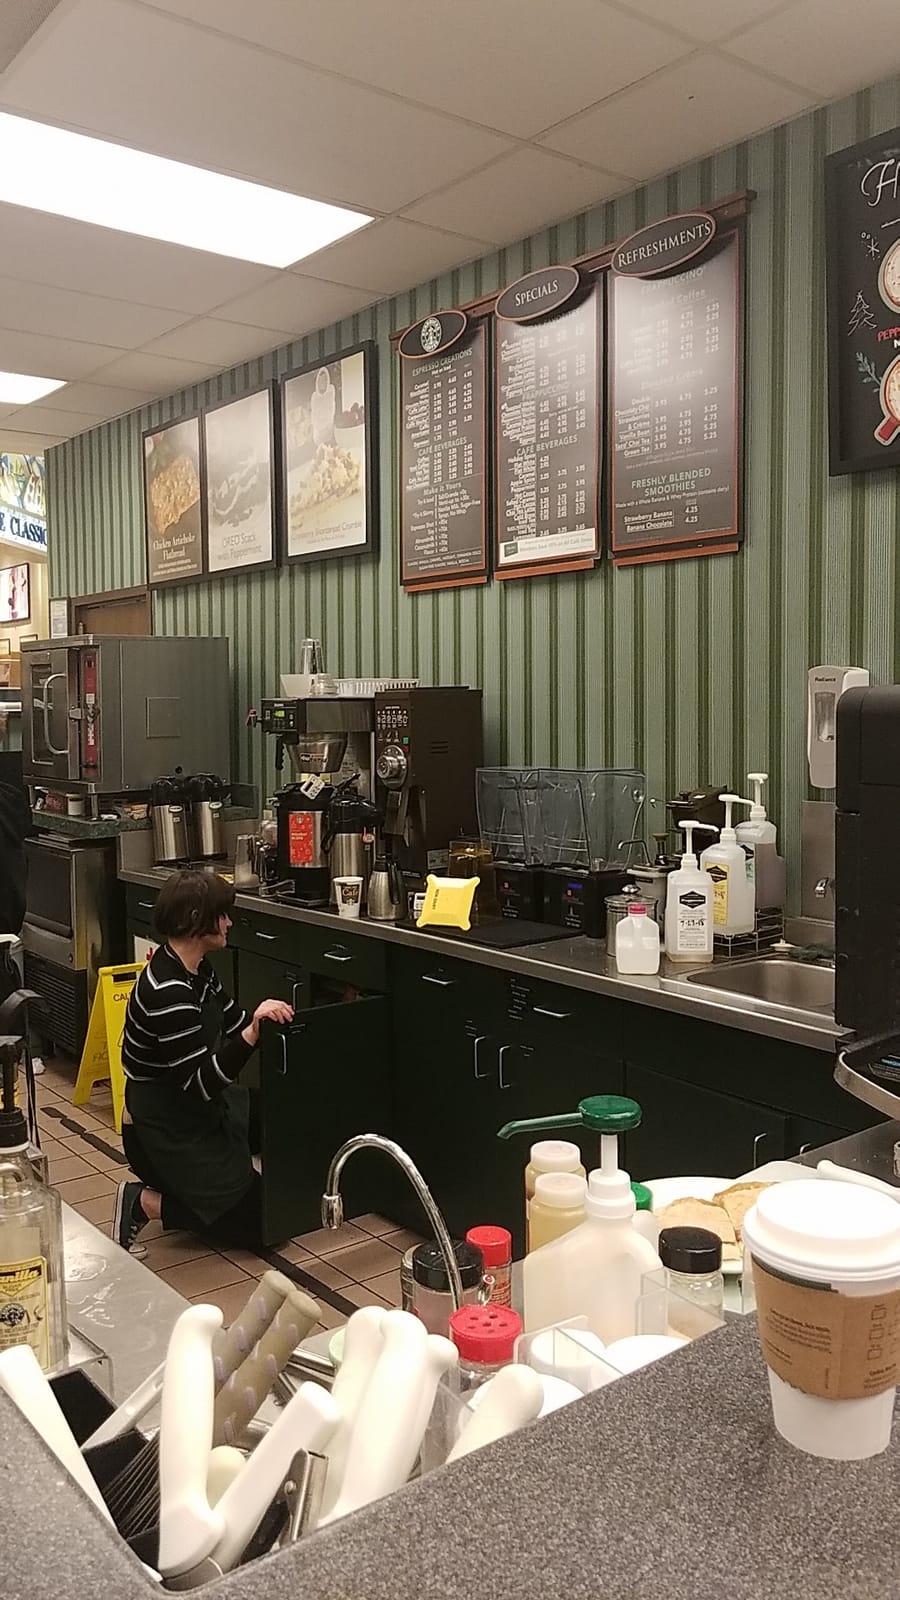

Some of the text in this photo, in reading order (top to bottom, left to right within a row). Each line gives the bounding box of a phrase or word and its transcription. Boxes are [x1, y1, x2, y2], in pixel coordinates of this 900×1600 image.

[618, 222, 711, 268] REFRESHMENTS
[515, 280, 559, 306] SPECIALS
[412, 347, 473, 377] ESPRESSO CREATIONS
[536, 434, 579, 452] BEVERAGES
[631, 467, 712, 489] FRESHLY BLENDED
[645, 480, 697, 497] SMOOTHIES
[623, 513, 652, 524] Strawberry
[653, 510, 673, 519] Banana
[626, 524, 647, 533] Banana
[647, 519, 673, 530] Chocolate
[172, 532, 196, 546] Artichoke
